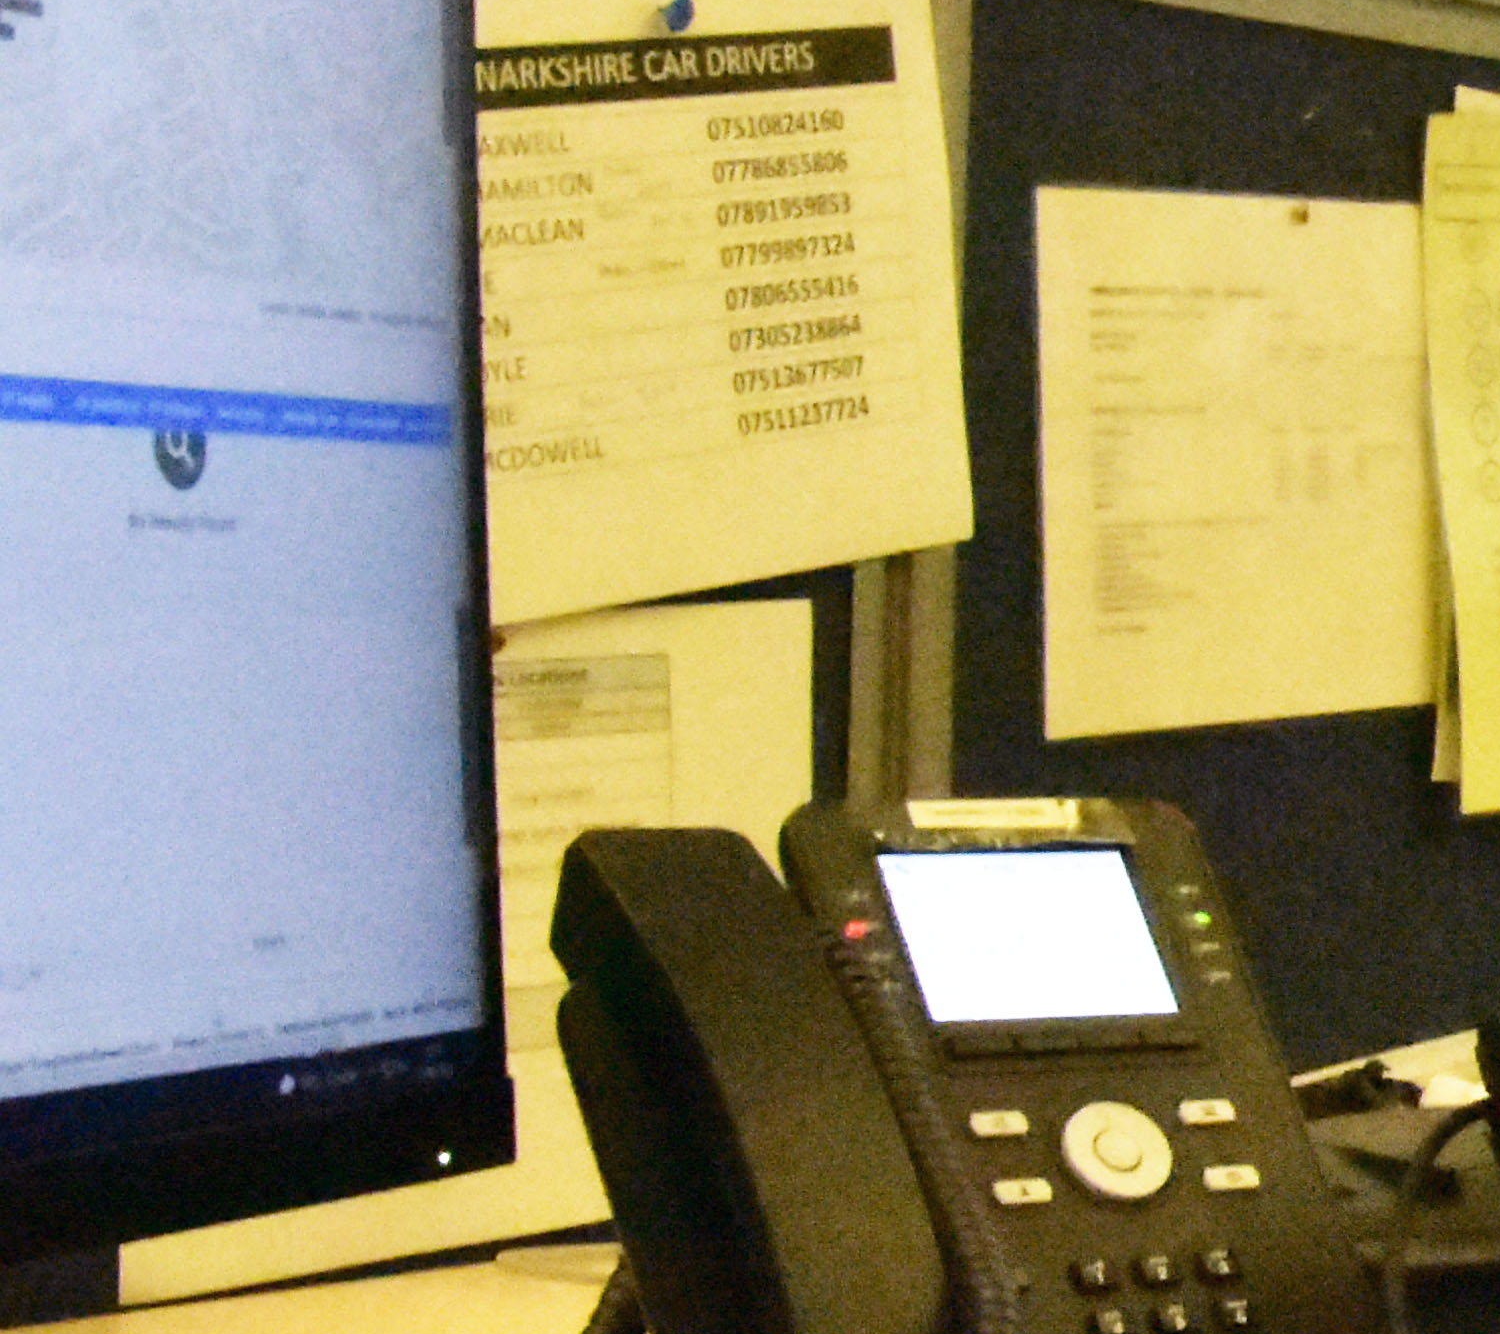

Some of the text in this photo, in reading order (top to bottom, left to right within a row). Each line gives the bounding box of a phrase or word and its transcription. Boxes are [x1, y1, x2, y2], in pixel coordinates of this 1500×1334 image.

[475, 40, 816, 93] NARKSHIRE CAR DRIVERS
[477, 173, 593, 202] AMILTON
